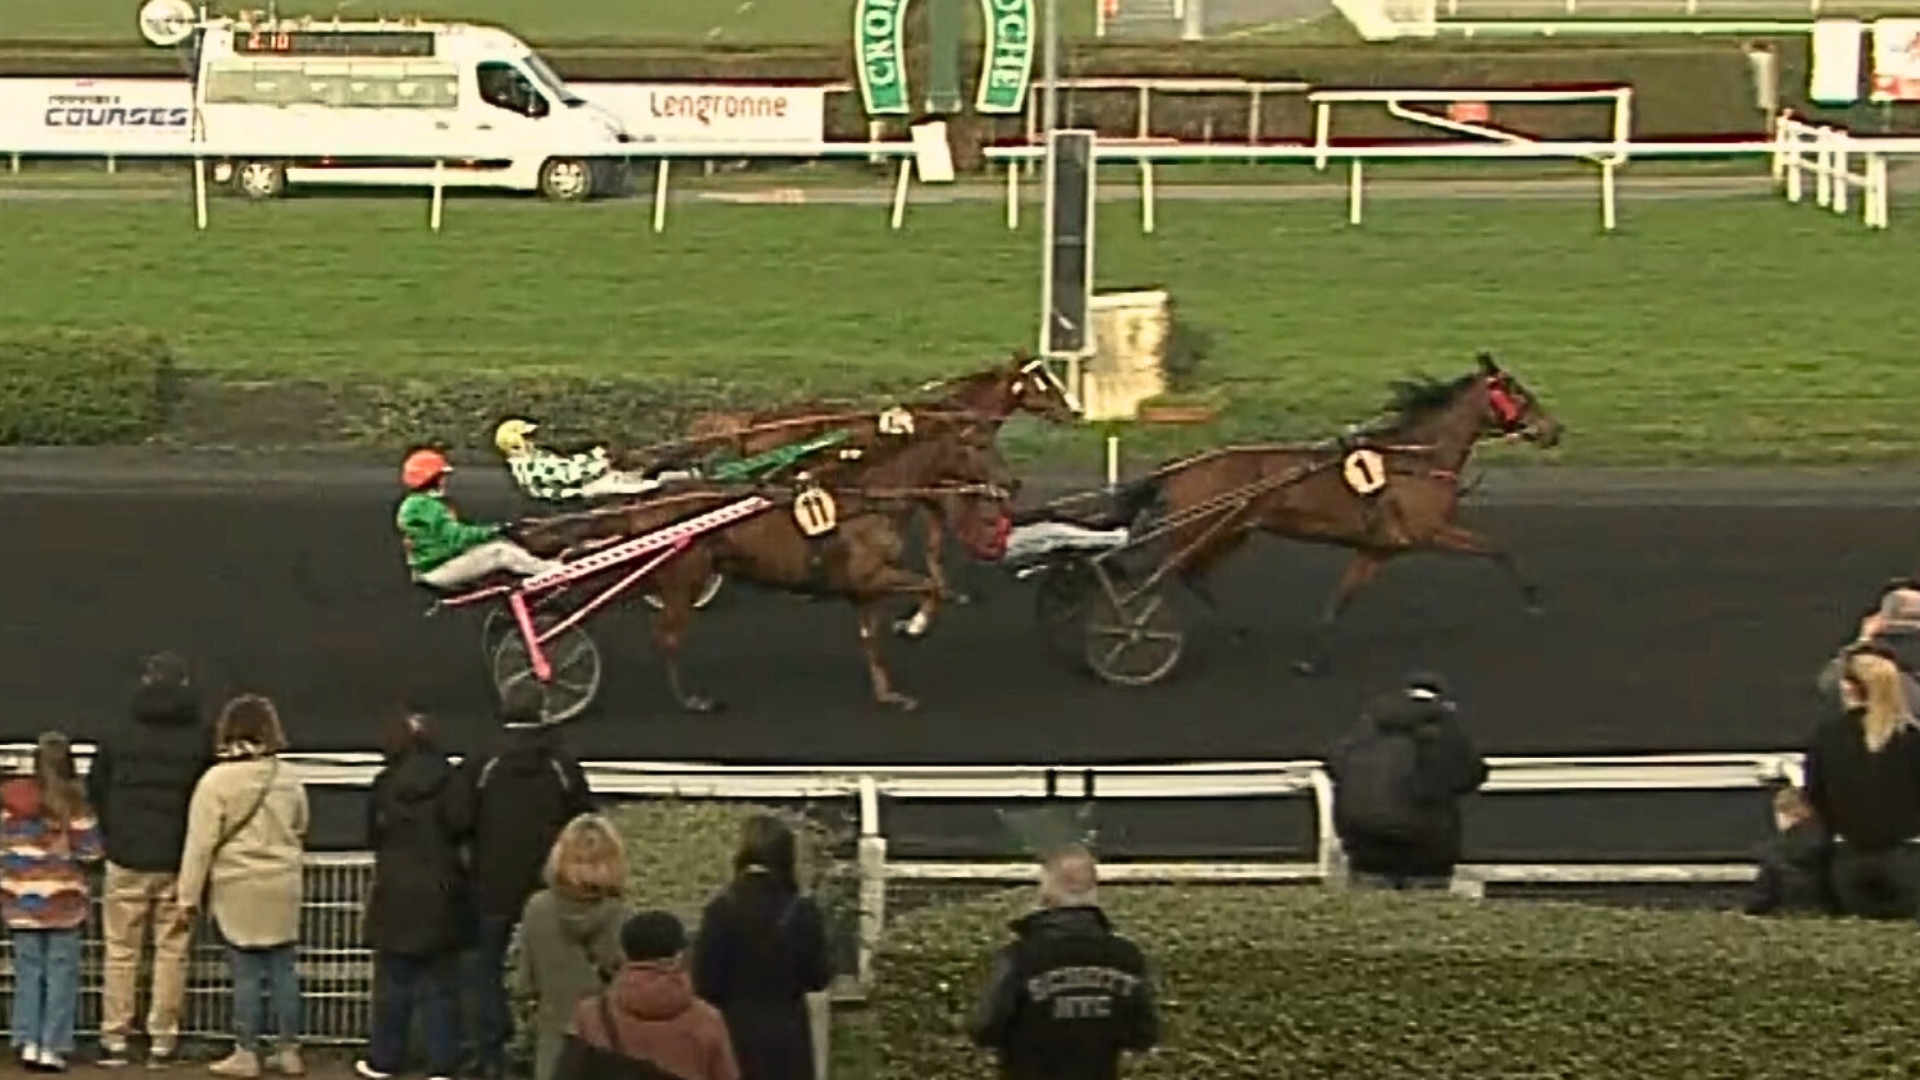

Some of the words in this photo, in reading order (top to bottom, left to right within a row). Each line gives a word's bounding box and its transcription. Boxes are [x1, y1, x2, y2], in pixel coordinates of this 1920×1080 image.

[45, 107, 188, 126] COURSES
[650, 91, 787, 125] Lengronne
[1353, 458, 1375, 485] 1
[801, 496, 830, 527] 11
